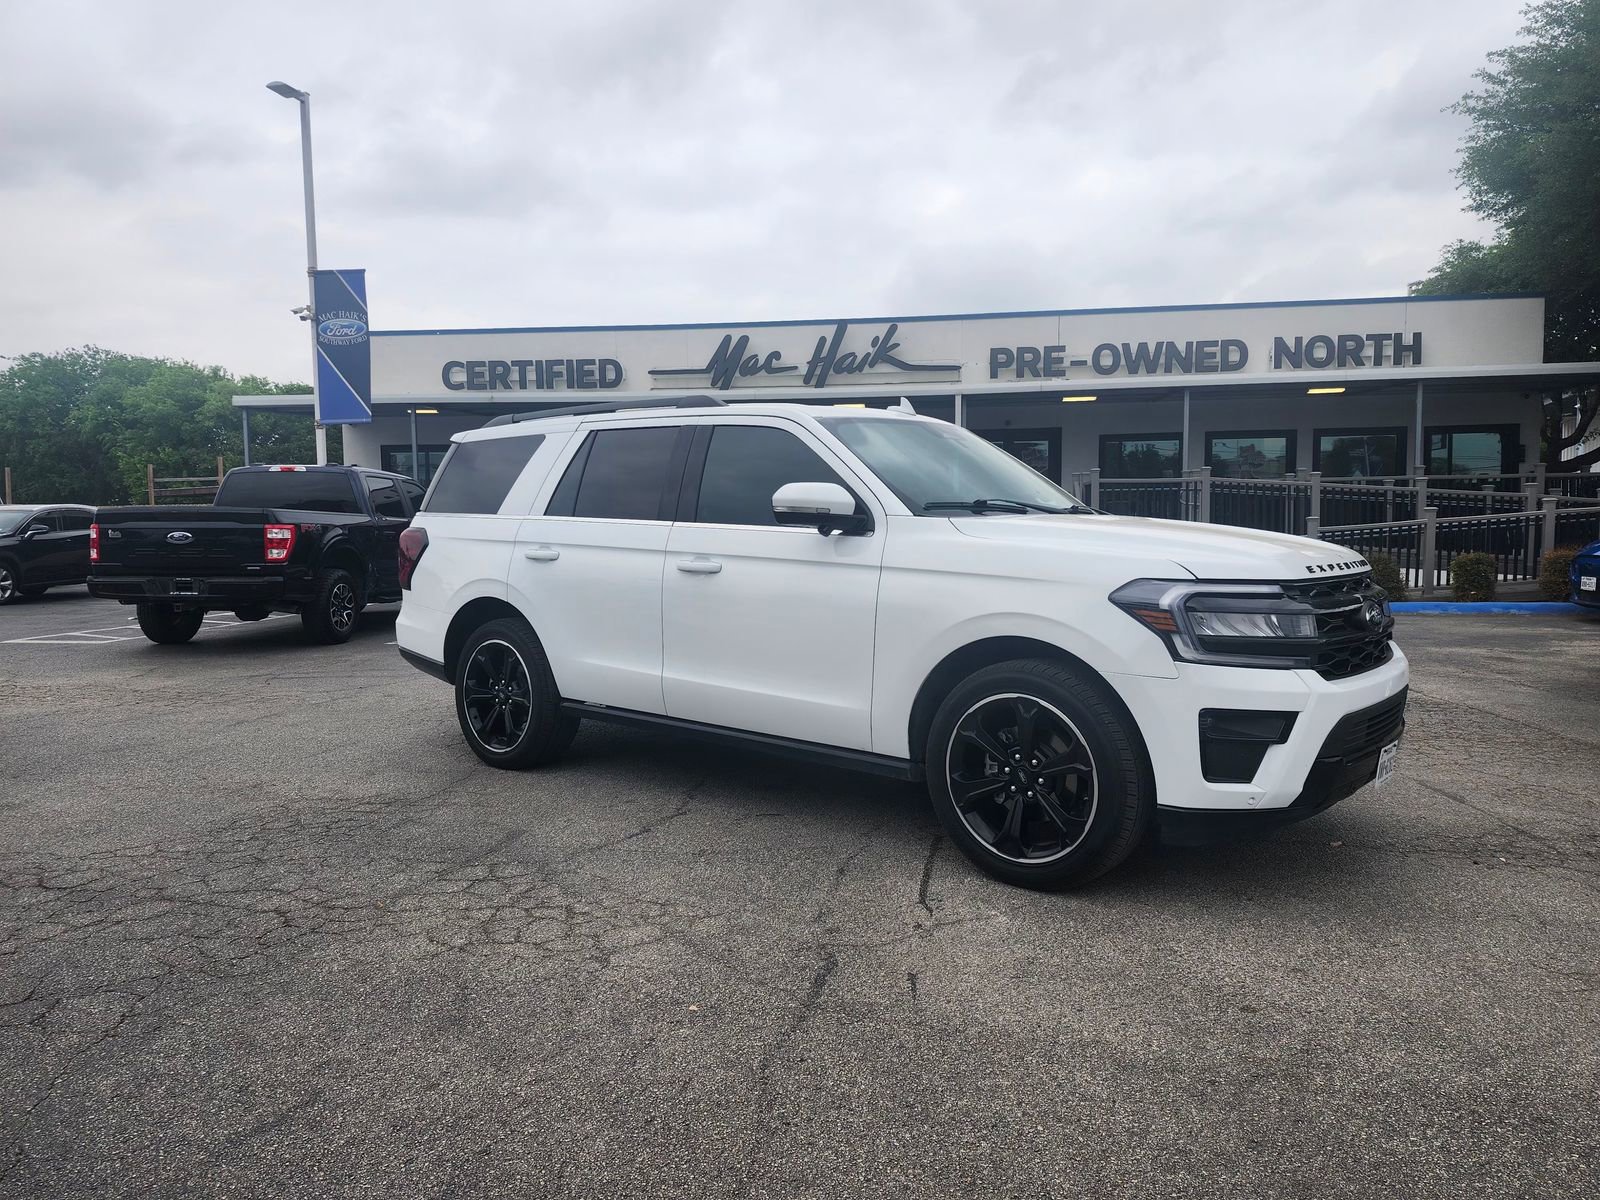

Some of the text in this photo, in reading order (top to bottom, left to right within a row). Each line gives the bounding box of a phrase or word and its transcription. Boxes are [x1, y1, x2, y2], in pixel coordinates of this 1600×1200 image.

[318, 310, 367, 322] MAC HAIK'S
[327, 321, 357, 336] Ford
[319, 334, 368, 346] SOUTHWAY FORD
[648, 320, 962, 391] Mac Haik
[989, 331, 1423, 380] PRE-OWNED NORTH
[441, 358, 623, 391] CERTIFIED
[1305, 559, 1369, 574] EXPEDITIO
